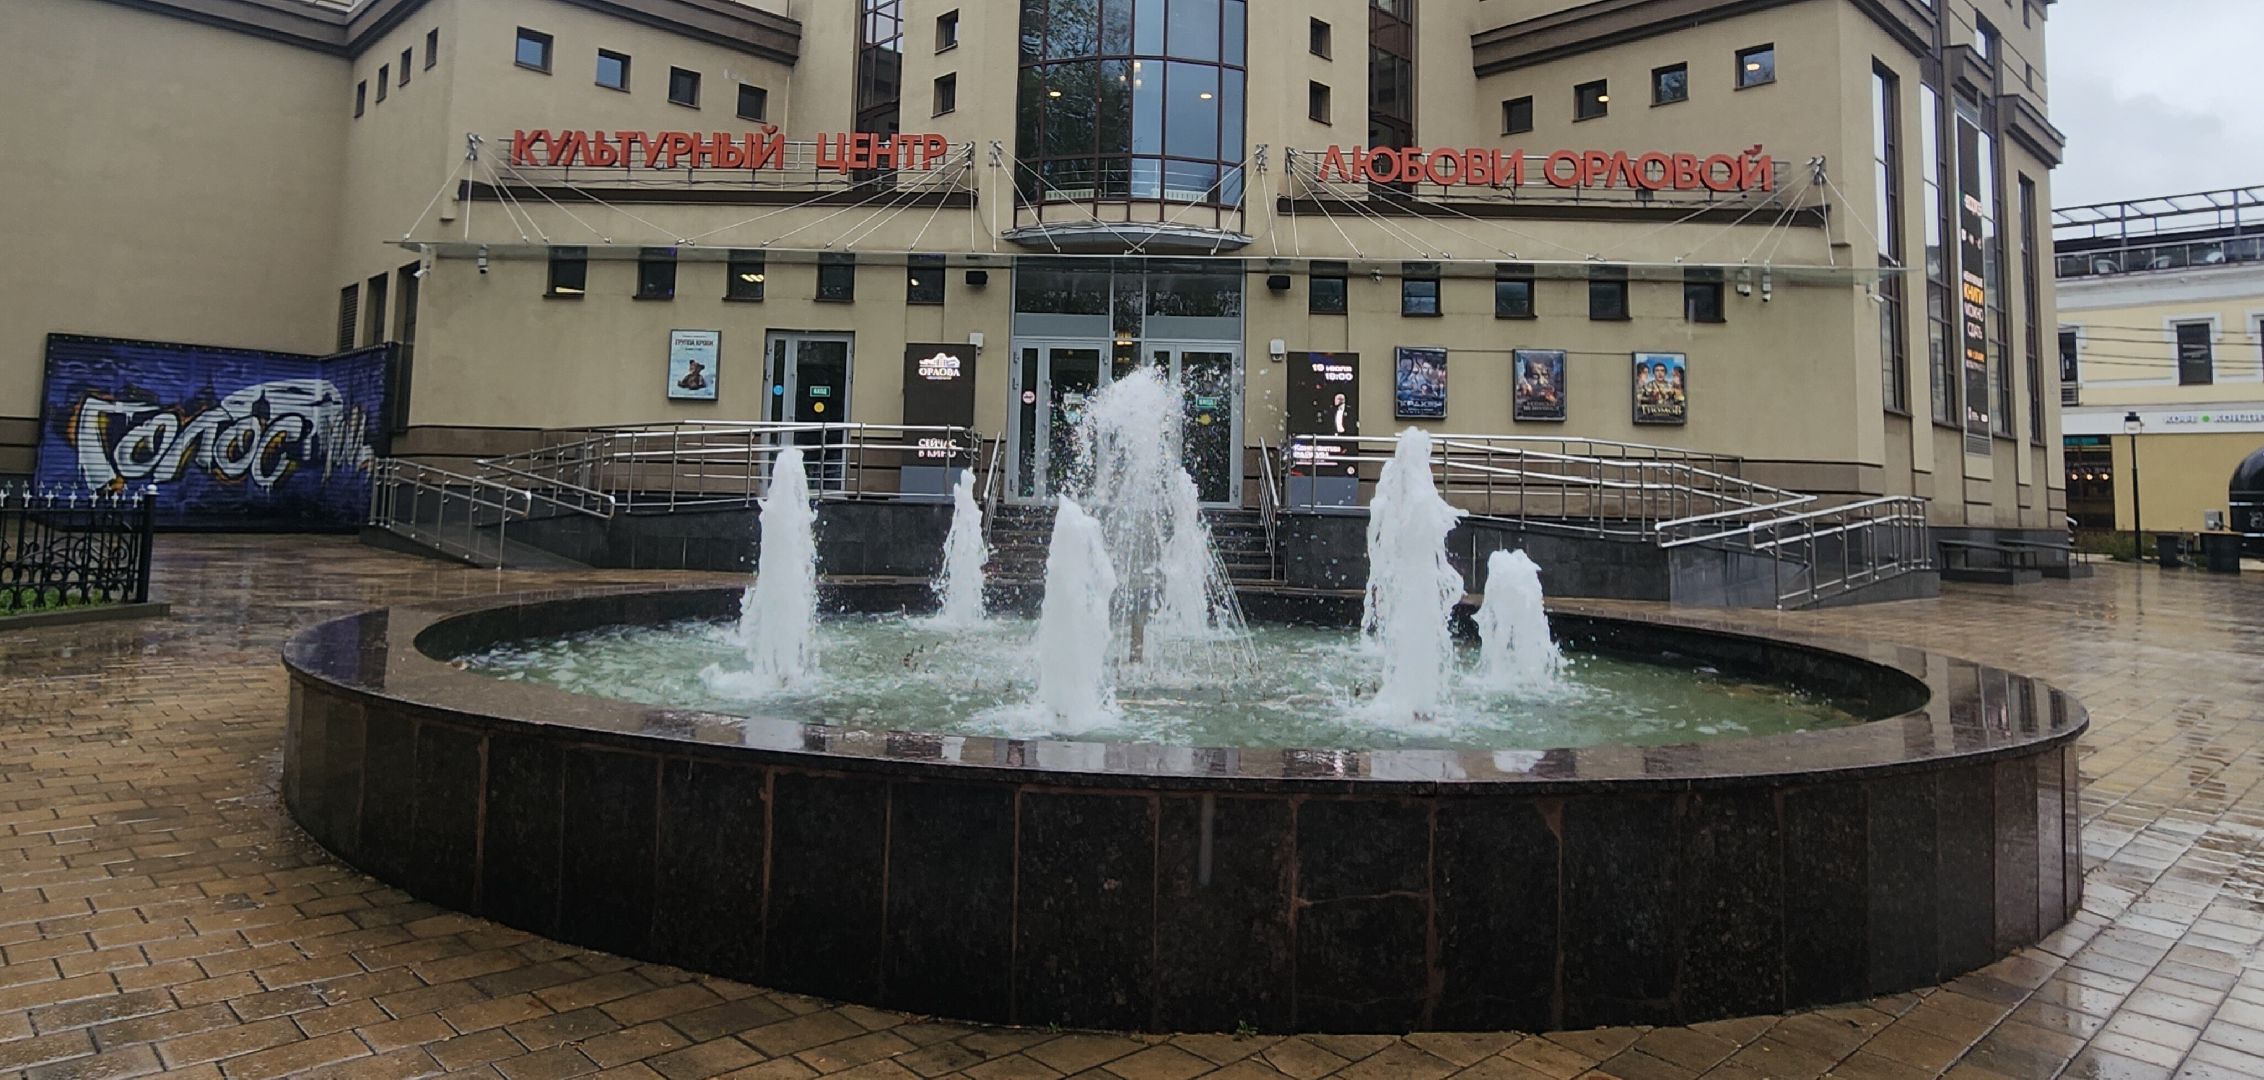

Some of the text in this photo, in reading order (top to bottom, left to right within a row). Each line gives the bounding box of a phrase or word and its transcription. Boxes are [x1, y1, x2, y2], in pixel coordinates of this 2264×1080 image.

[512, 124, 948, 175] КУЛЬТУРНЫЙ ЦЕНТР
[1317, 144, 1773, 192] ЛЮБОВИ ОРЛОВОЙ
[918, 367, 961, 377] ОРЛОВА
